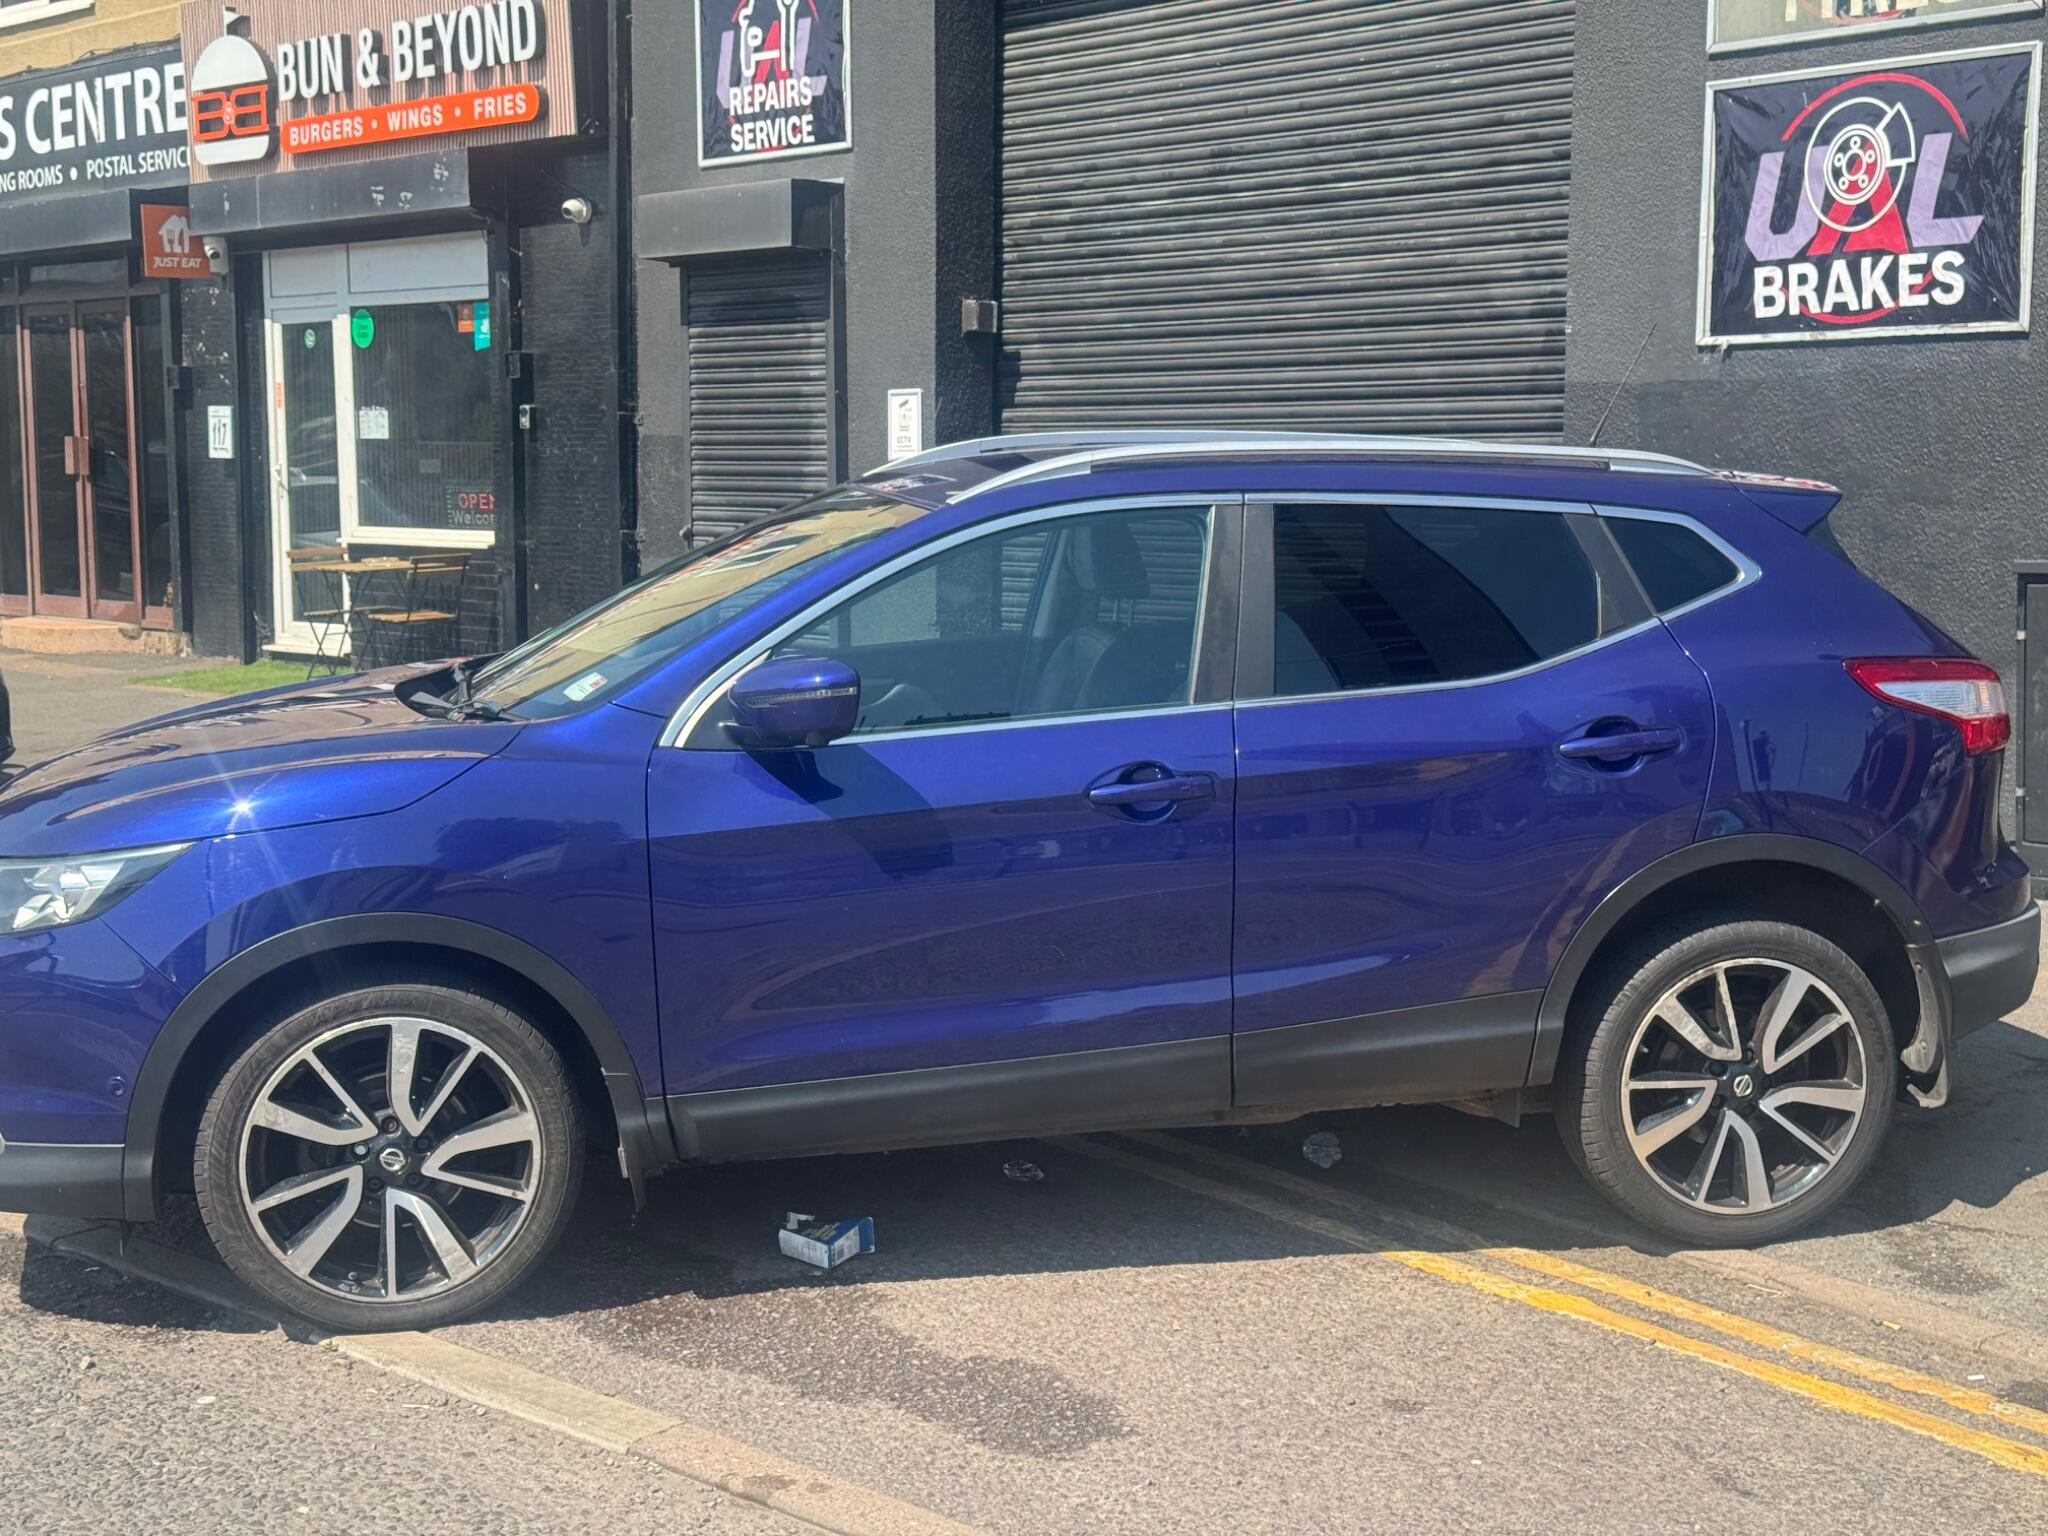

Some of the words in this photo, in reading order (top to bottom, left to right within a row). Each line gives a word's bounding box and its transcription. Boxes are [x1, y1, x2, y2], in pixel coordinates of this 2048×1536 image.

[277, 33, 344, 102] BUN
[356, 27, 380, 88] &
[391, 0, 537, 83] BEYOND
[25, 62, 188, 154] CENTRE
[289, 117, 363, 147] BURGERS
[387, 104, 443, 132] WINGS
[473, 92, 527, 120] FRIES
[729, 76, 812, 116] REPAIRS
[730, 114, 816, 152] SERVICE
[18, 164, 64, 190] ROOMS
[86, 156, 136, 180] POSTAL
[138, 146, 190, 173] SERVIC
[153, 256, 180, 269] JUST
[181, 257, 202, 268] EAT
[1754, 250, 1965, 319] BRAKES
